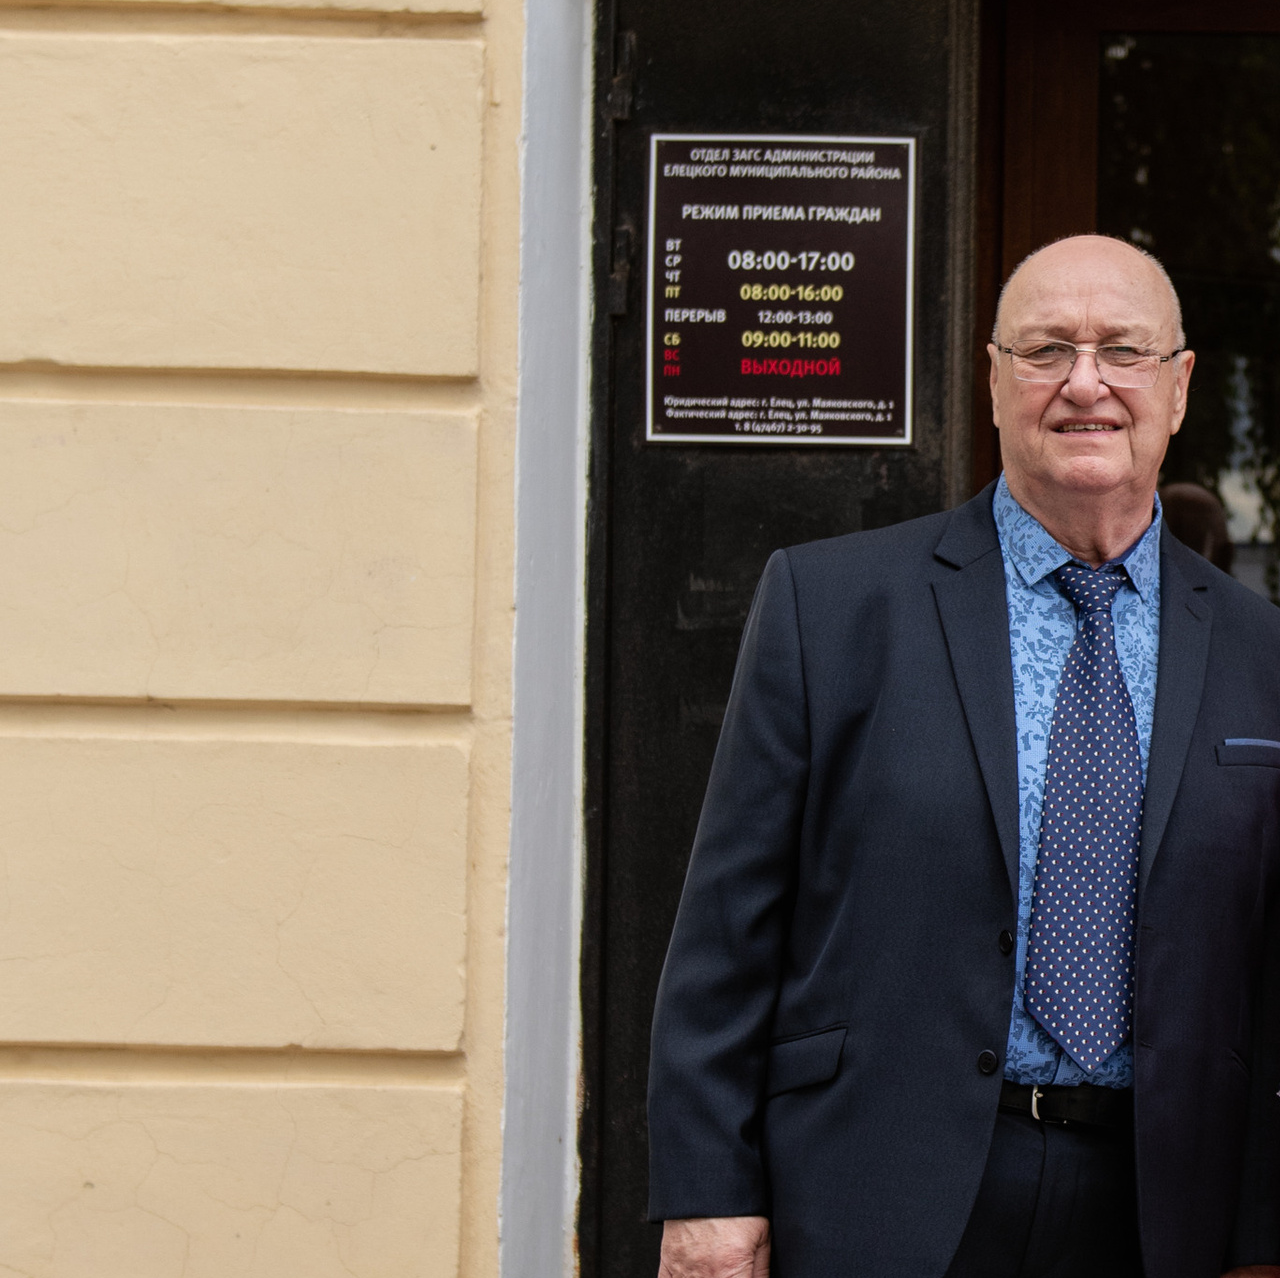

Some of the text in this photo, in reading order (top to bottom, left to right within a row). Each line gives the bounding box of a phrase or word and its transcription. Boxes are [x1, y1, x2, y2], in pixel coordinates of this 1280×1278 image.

[691, 149, 874, 164] ОТДЕЛ ЗАГС АДМИНИСТРАЦИИ
[664, 164, 901, 179] ЕЛЕЦКОГО МУНИЦИПАЛЬНОГО РАЙОНА
[683, 205, 881, 223] РЕЖИМ ПРИЕМА ГРАЖДАН
[666, 239, 681, 251] ВТ
[665, 255, 681, 267] СР
[728, 251, 854, 271] 08:00-17:00
[666, 270, 680, 282] ЧТ
[666, 284, 843, 301] ПТ 08:00-16:00
[665, 309, 833, 324] ПЕРЕРЫВ 12:00-13:00
[664, 331, 840, 348] СБ 09:00-11:00
[664, 350, 678, 360] ВС
[664, 365, 680, 375] ПН
[741, 358, 840, 377] ВЫХОДНОЙ
[664, 396, 728, 408] Юридический
[730, 399, 759, 408] адрес:
[770, 398, 795, 409] Елец,
[797, 400, 810, 409] ул.
[812, 398, 876, 410] Маяковского,
[666, 409, 726, 419] Фактический
[728, 411, 757, 421] адрес:
[768, 410, 793, 420] Елец,
[795, 412, 808, 421] ул.
[810, 411, 875, 422] Маяковского,
